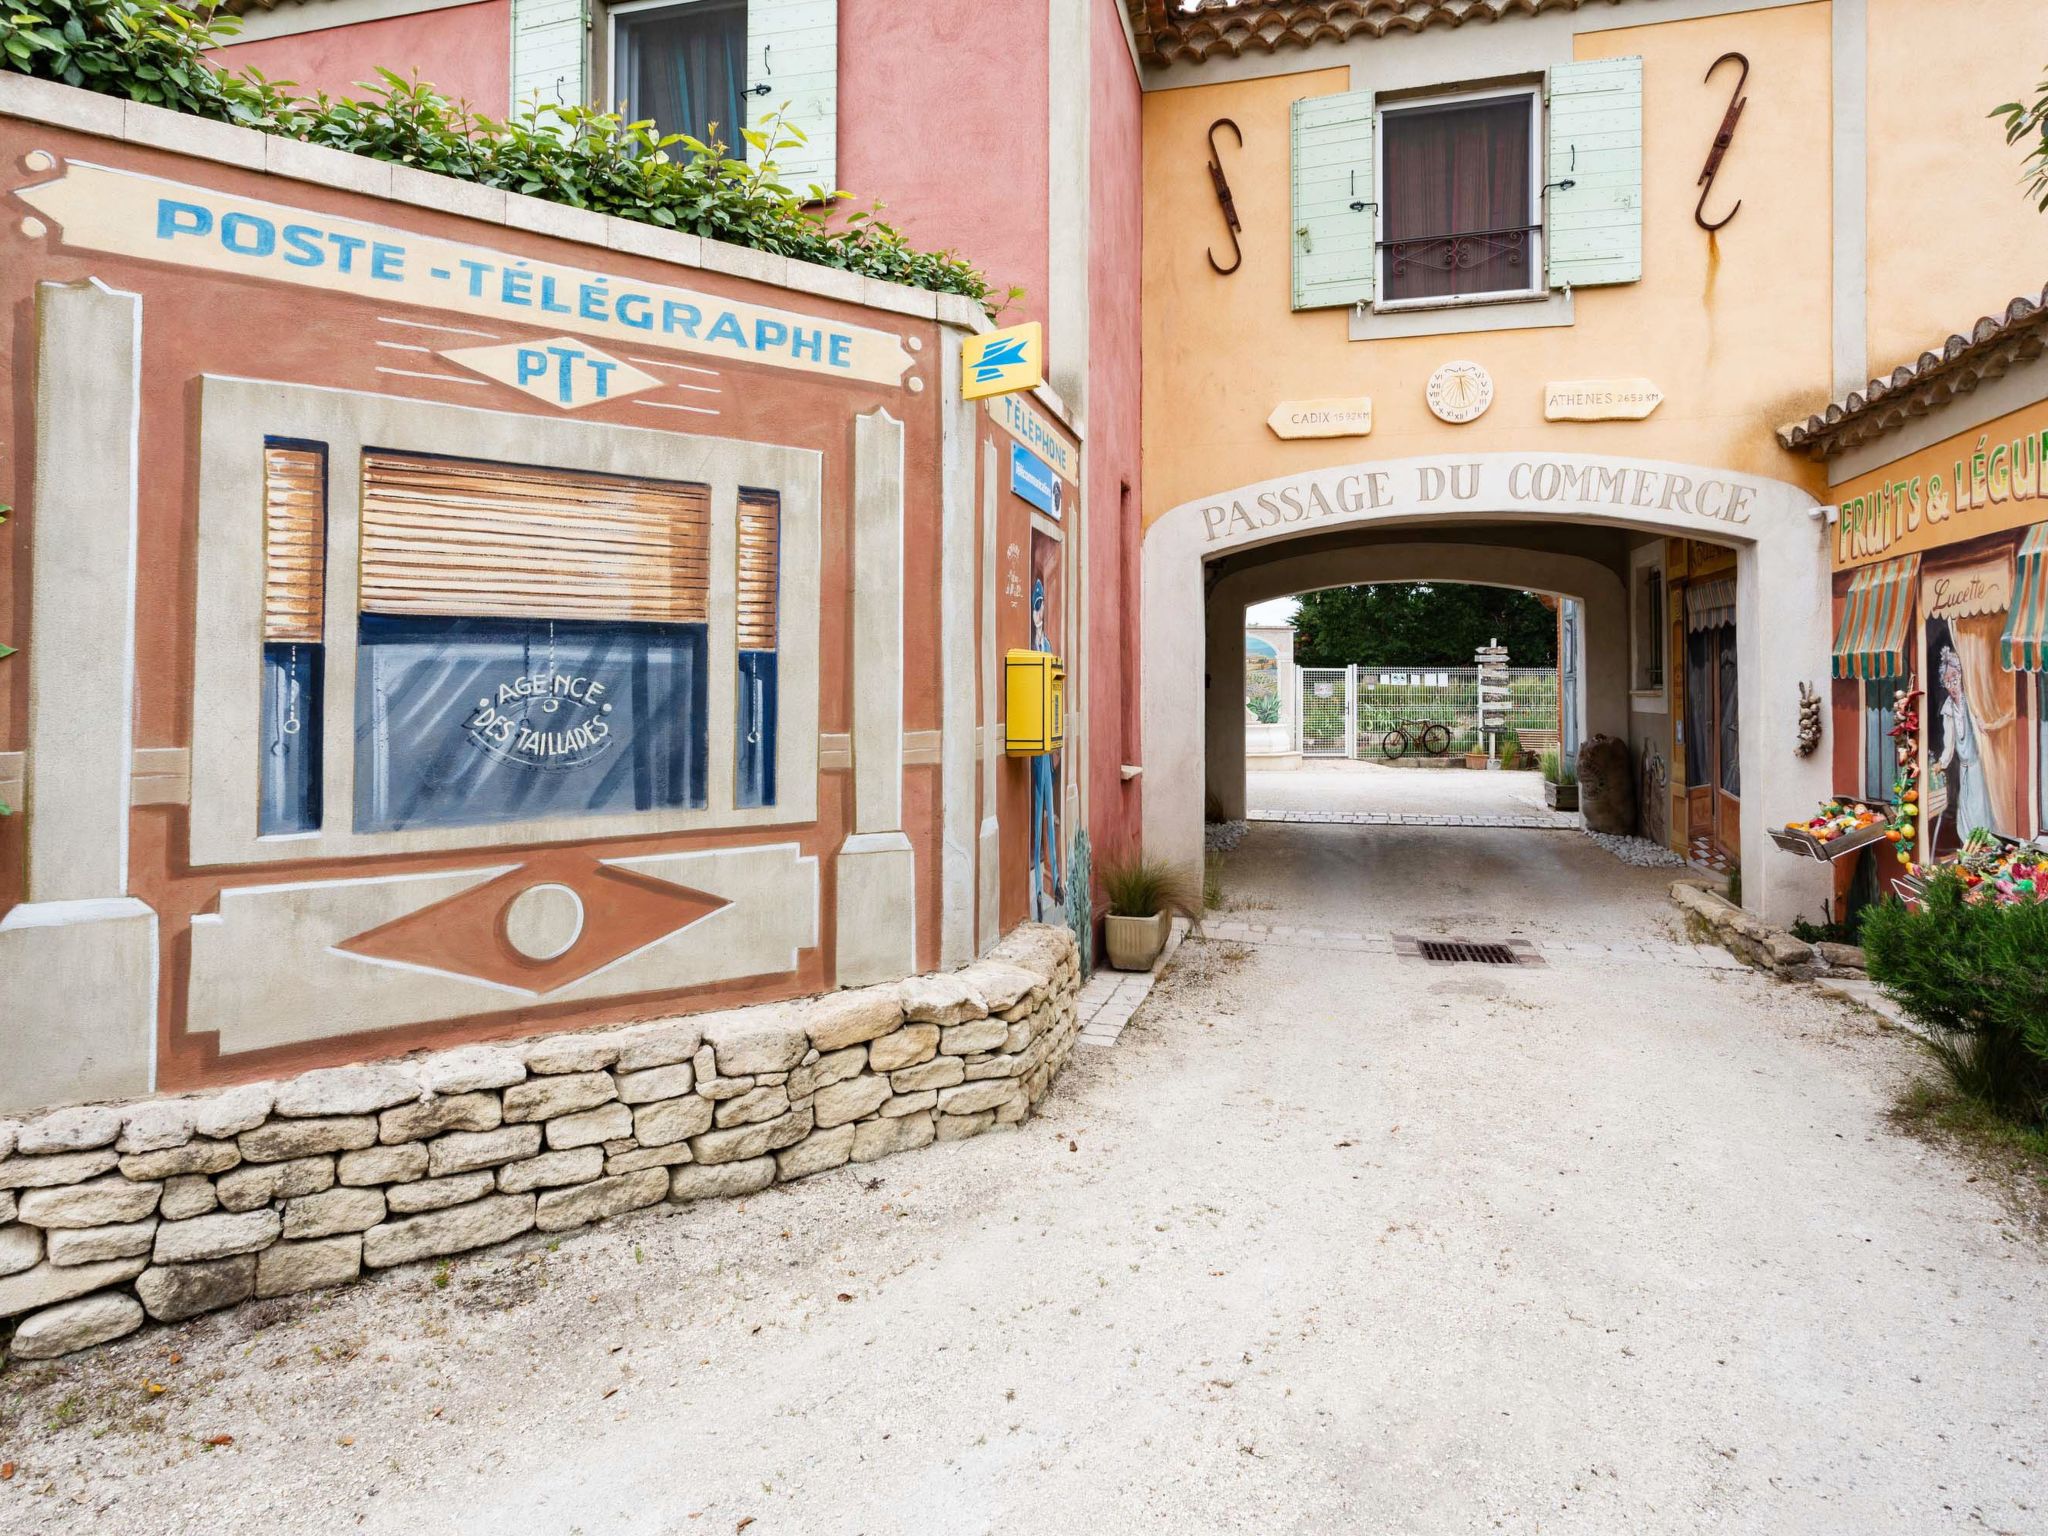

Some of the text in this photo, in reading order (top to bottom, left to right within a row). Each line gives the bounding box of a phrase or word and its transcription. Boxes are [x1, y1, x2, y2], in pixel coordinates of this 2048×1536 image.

[156, 198, 405, 283] POSTE
[517, 346, 617, 402] PTT
[1291, 411, 1330, 424] CADIX
[1549, 392, 1613, 407] ATHENES
[1004, 396, 1067, 471] TÉLÉPHONE
[1200, 462, 1757, 542] PASSAGE DU COMMERCE
[1926, 473, 1950, 525] &
[1932, 574, 1997, 612] Lucette
[499, 674, 605, 705] AGENCE
[473, 707, 609, 756] DES TAILLADES
